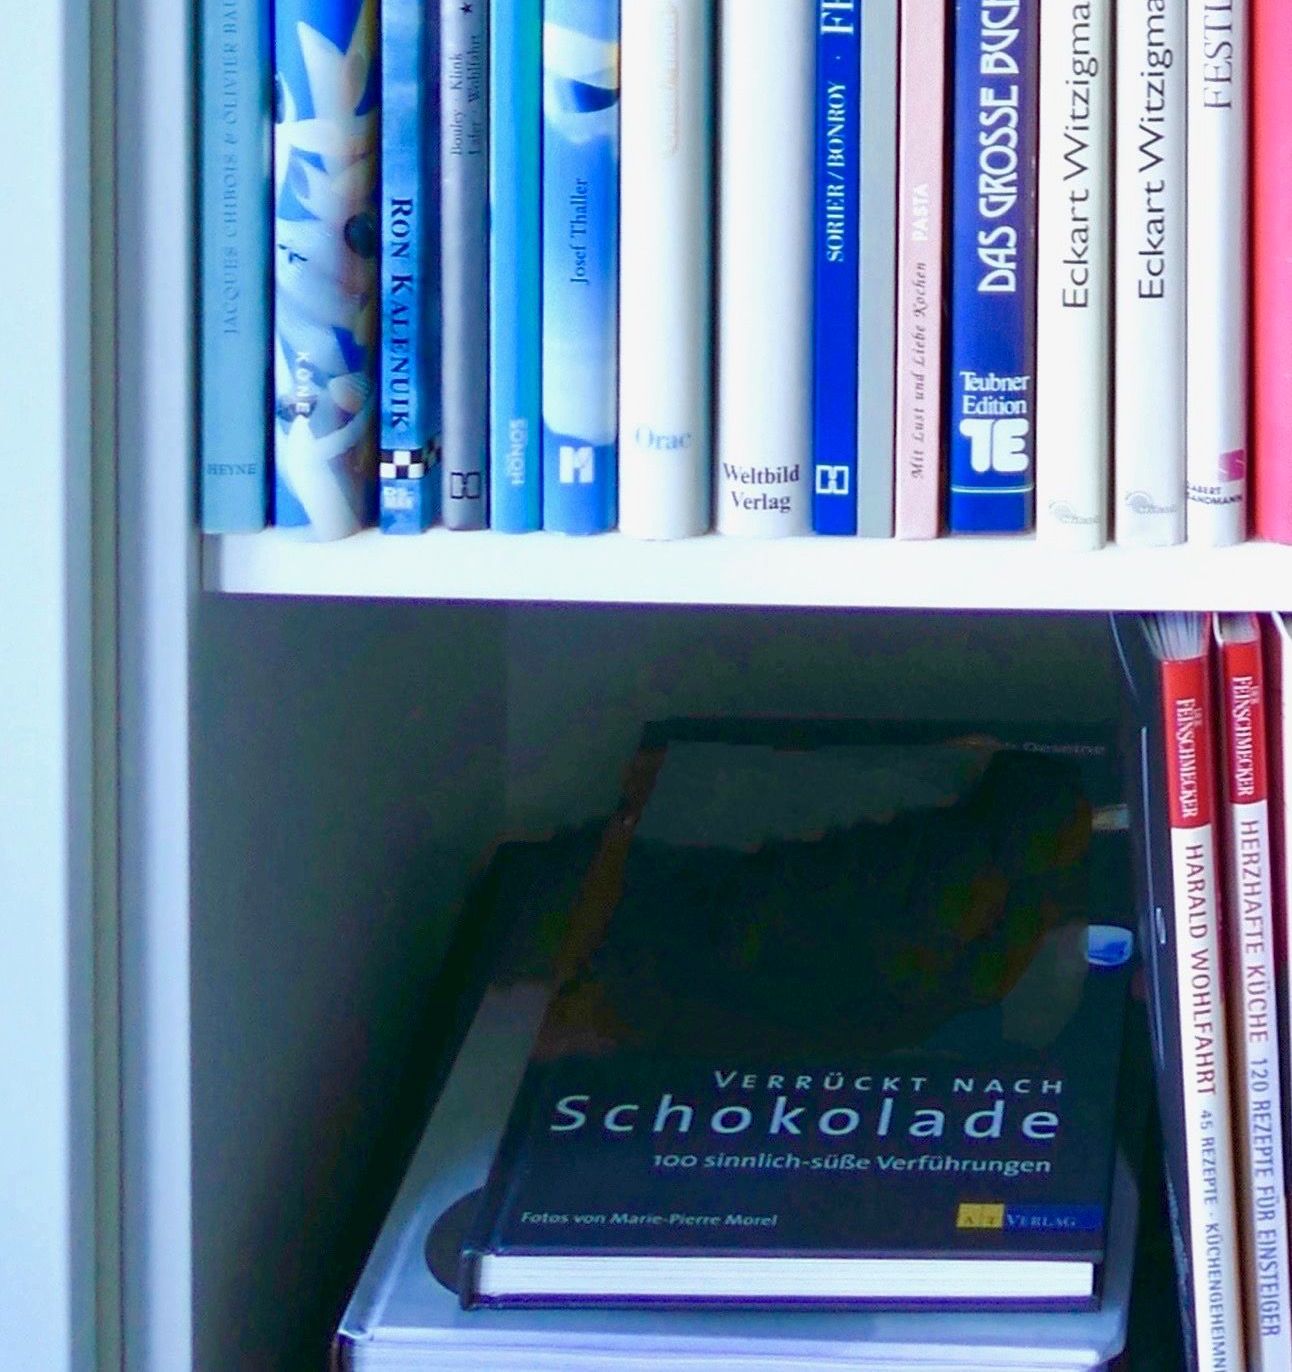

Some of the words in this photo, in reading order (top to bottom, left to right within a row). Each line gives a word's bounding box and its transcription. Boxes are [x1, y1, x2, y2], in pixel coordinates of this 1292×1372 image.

[1063, 190, 1088, 307] Eckart
[715, 1070, 927, 1091] VERRÜCKT
[954, 1077, 1063, 1094] NACH
[551, 1093, 1060, 1139] Schokolade
[652, 1154, 697, 1170] 100
[704, 1150, 871, 1173] sinnlich-süße
[877, 1154, 1051, 1176] Verführungen
